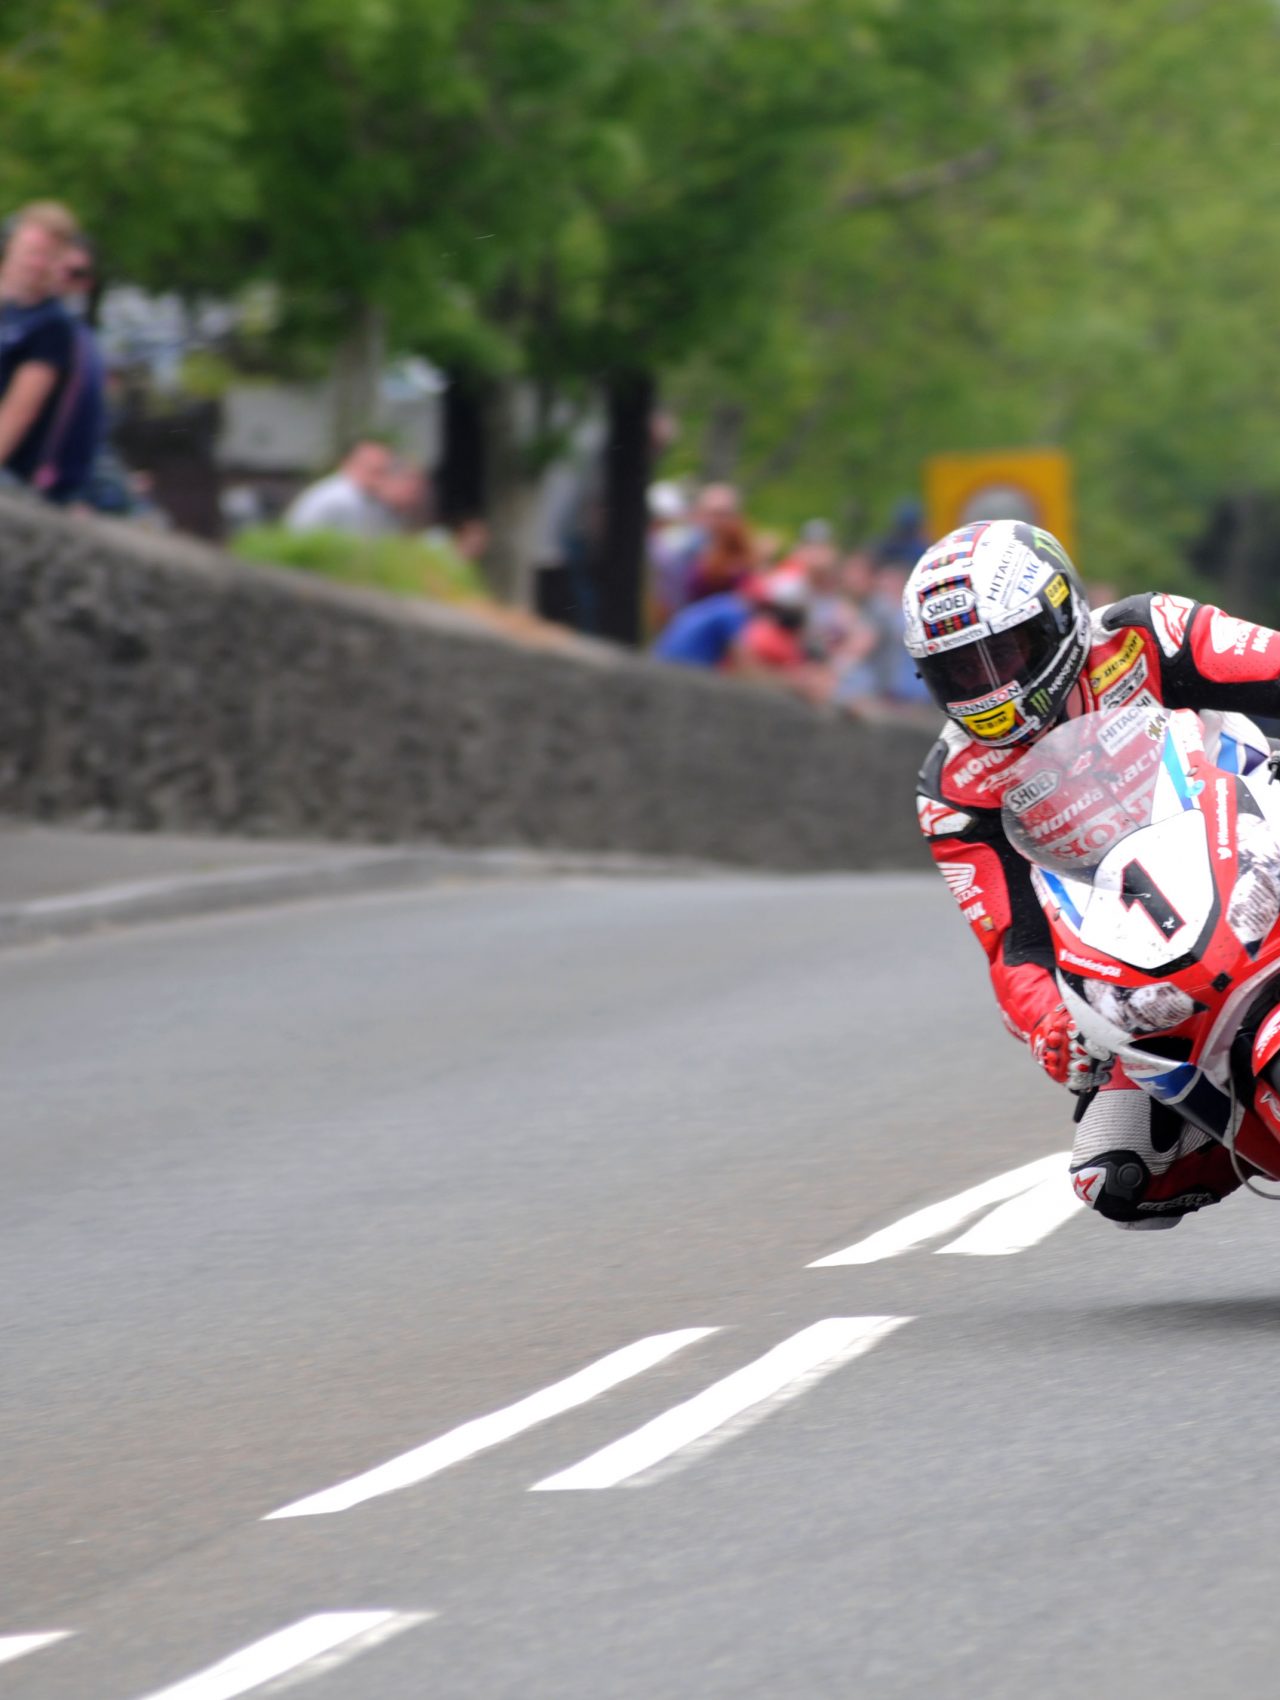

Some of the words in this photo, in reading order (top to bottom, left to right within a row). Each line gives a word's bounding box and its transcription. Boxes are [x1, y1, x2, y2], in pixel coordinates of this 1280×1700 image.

[927, 593, 966, 618] SHOEI
[948, 685, 1020, 715] DENNISON
[1101, 695, 1151, 743] HITACHI
[1010, 775, 1053, 810] SHOEI
[1119, 858, 1186, 943] 1
